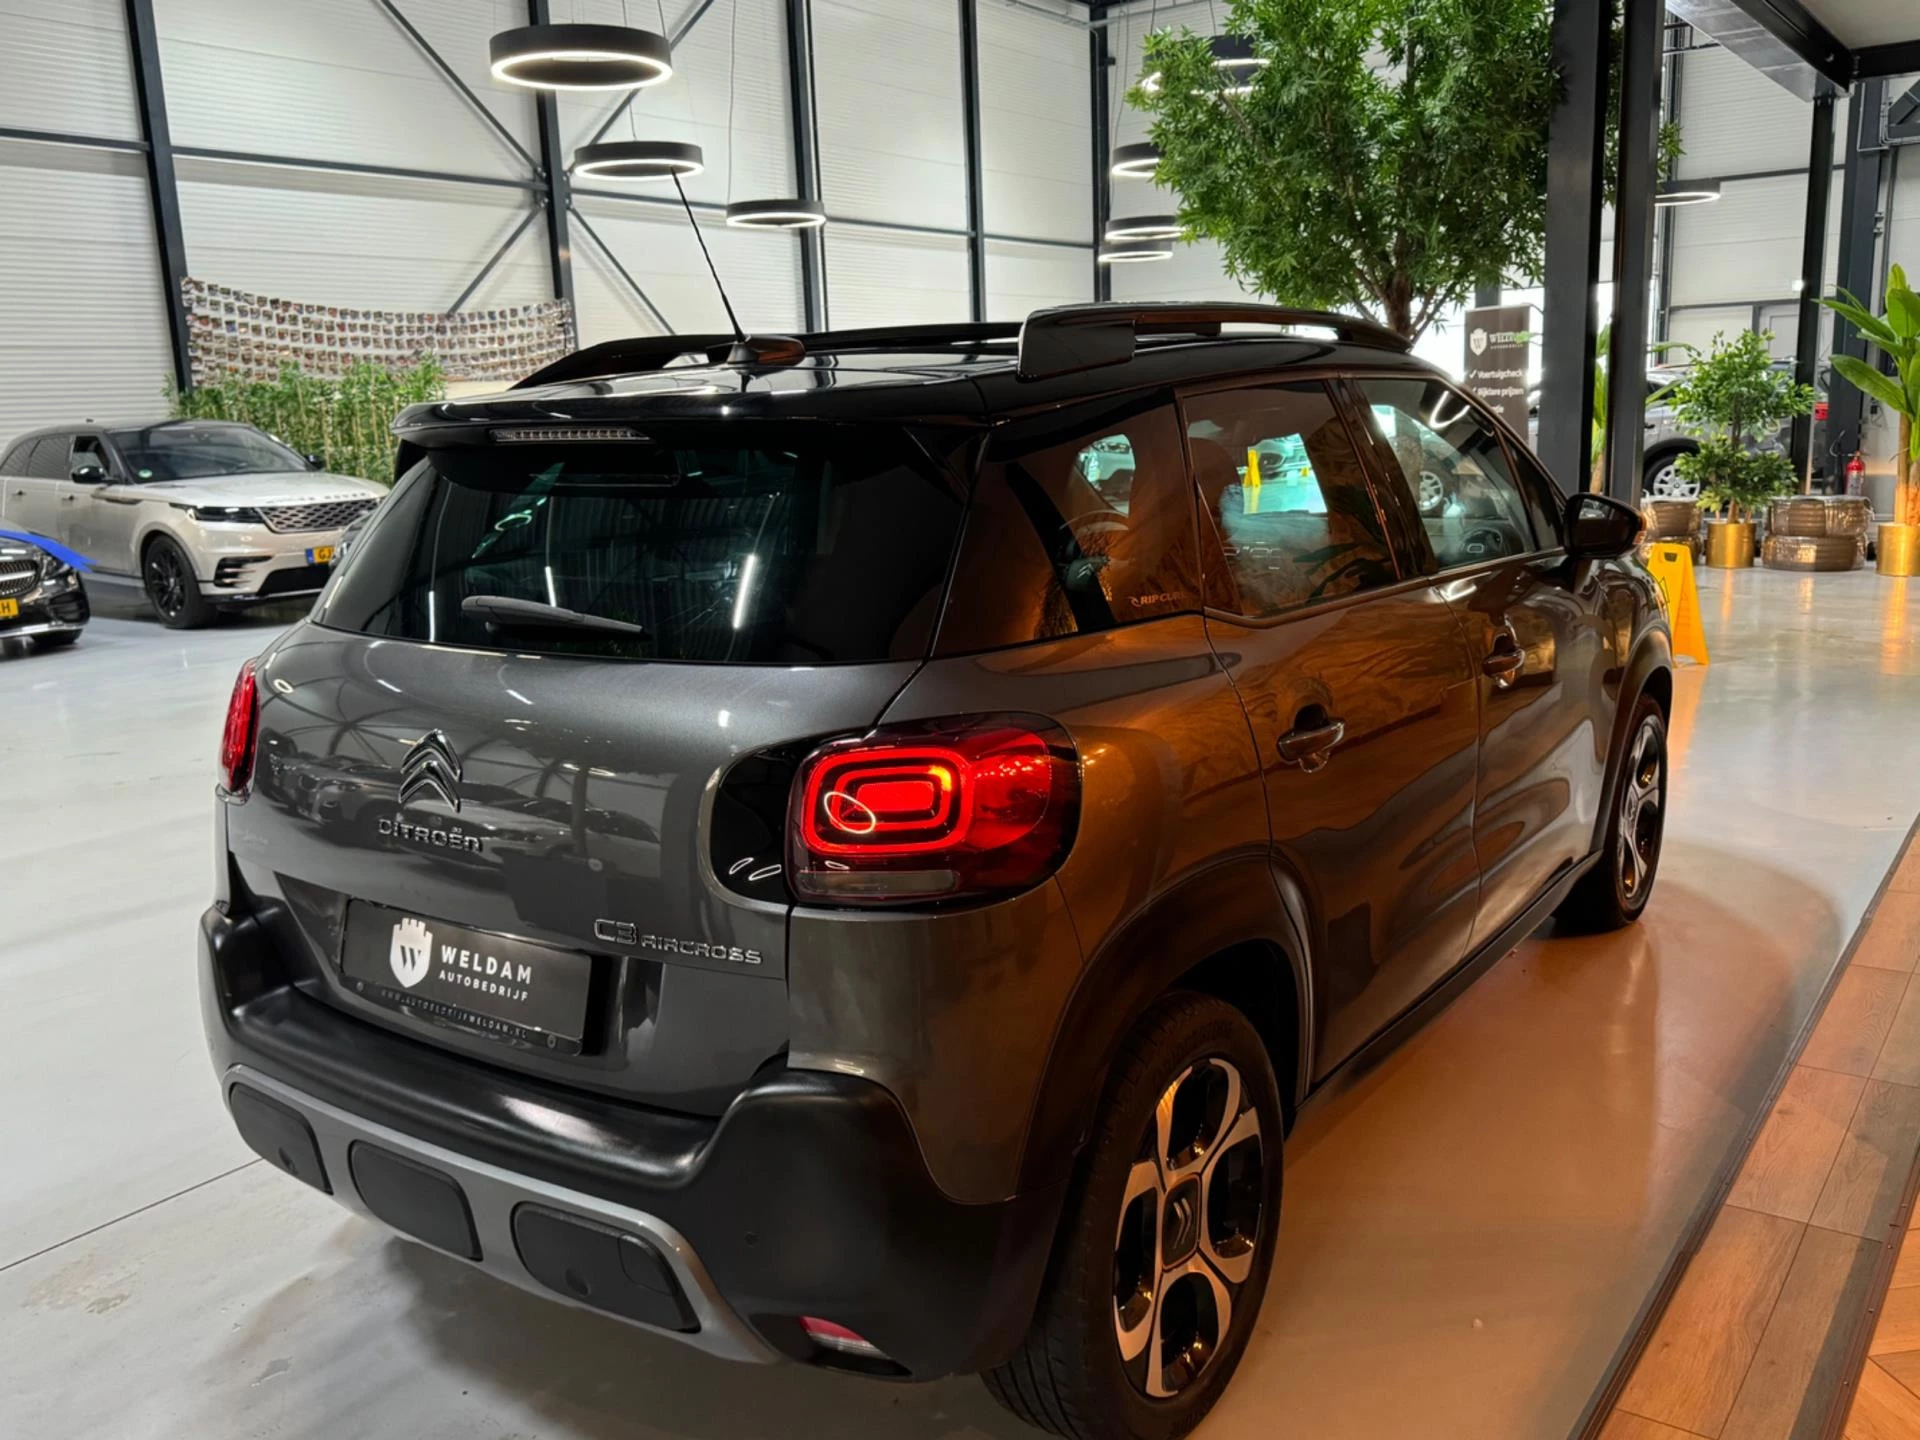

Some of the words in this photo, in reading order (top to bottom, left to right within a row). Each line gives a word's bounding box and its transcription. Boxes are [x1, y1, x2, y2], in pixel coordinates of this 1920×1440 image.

[1140, 594, 1159, 605] RIP
[379, 818, 483, 852] CITROËN
[594, 918, 637, 945] C3
[641, 934, 763, 965] AIRCROSS
[441, 944, 533, 985] WELDAM
[438, 969, 529, 1002] AUTOBEDRIJF
